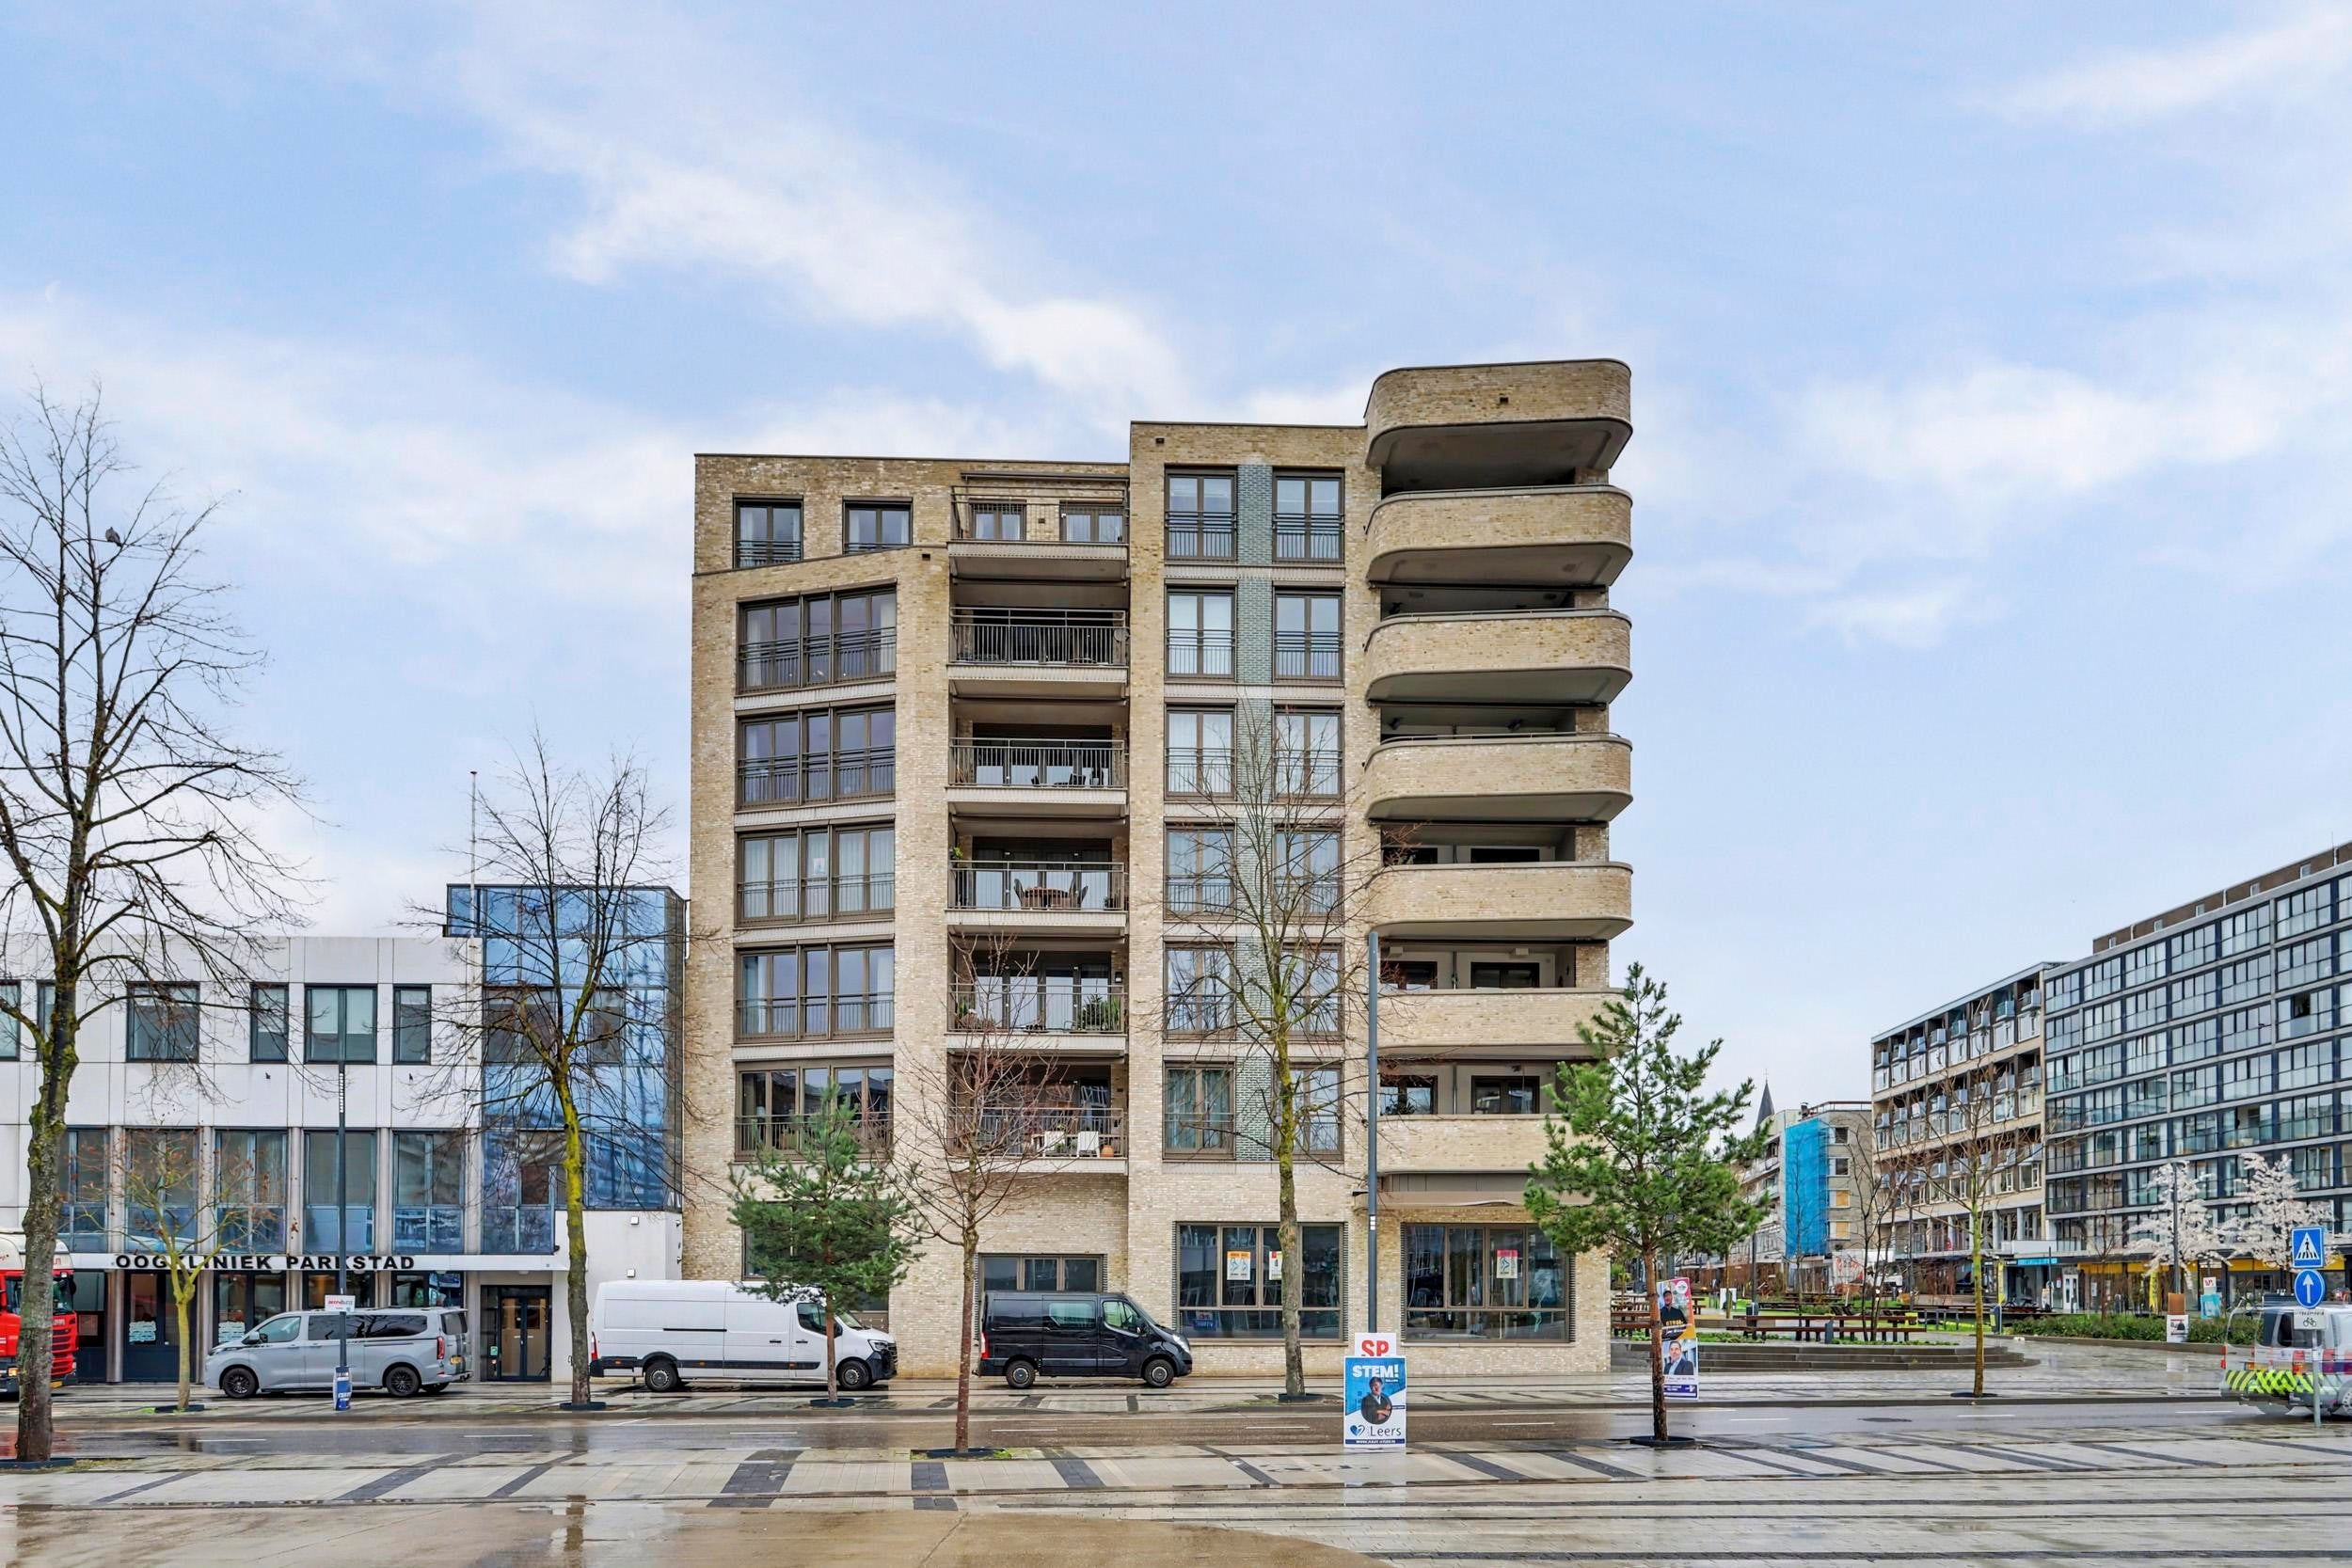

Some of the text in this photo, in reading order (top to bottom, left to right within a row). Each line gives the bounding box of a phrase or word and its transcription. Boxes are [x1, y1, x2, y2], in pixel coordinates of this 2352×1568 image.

[116, 1255, 273, 1269] OOGLINIEK
[1361, 1339, 1390, 1356] SP
[1352, 1364, 1399, 1378] STEM!
[1370, 1425, 1402, 1437] Leers
